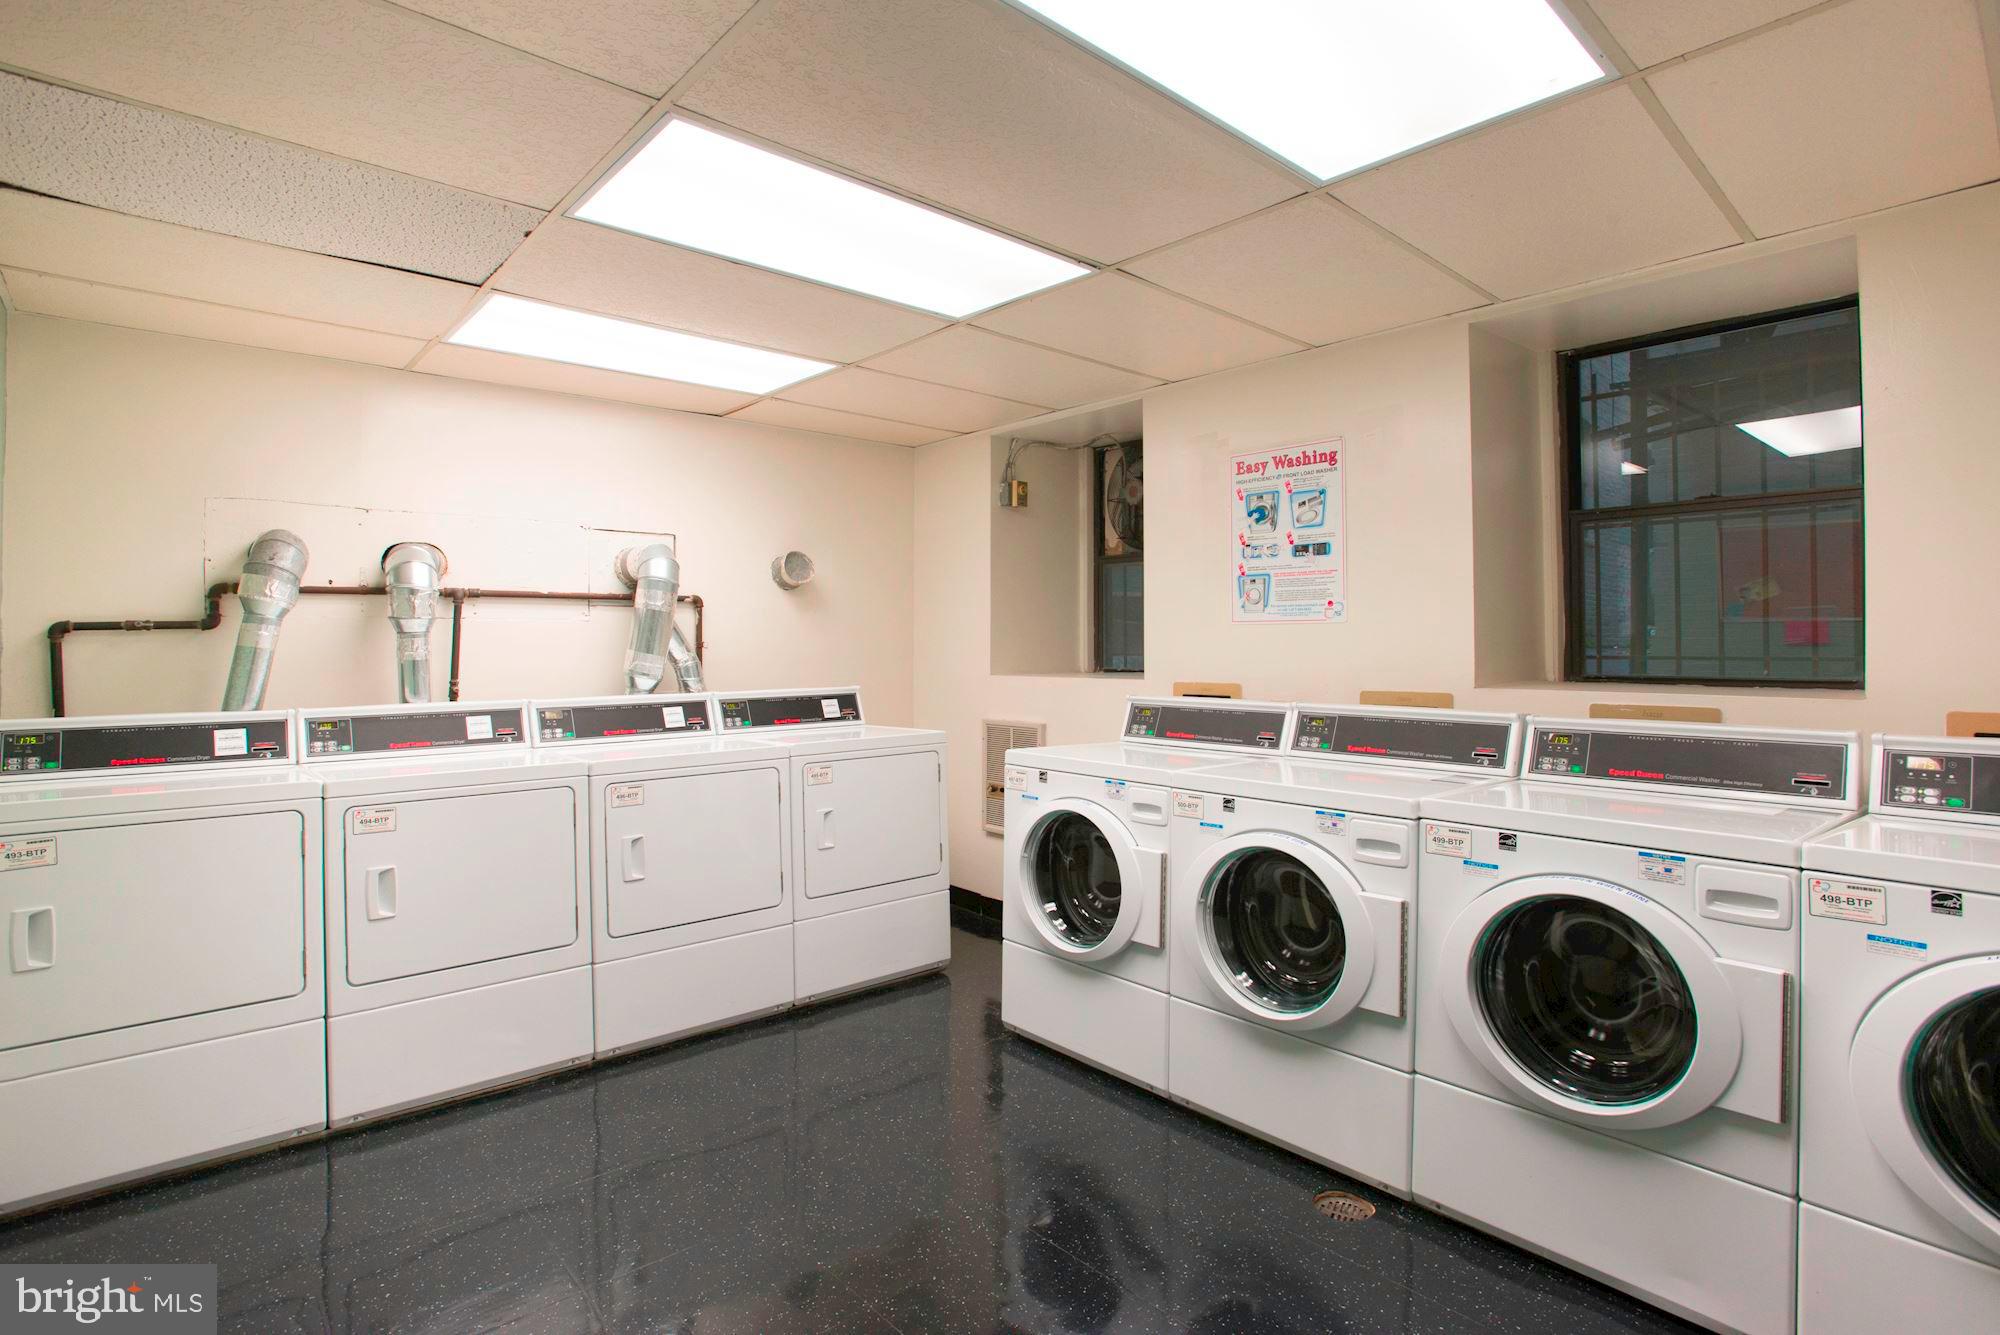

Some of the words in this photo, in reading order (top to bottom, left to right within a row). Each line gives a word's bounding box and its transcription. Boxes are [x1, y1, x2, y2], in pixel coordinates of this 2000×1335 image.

[1235, 461, 1269, 476] Easy
[1271, 449, 1338, 471] Washing
[20, 736, 37, 744] 175
[1554, 736, 1569, 745] 175
[1664, 773, 1698, 782] Commercial
[1699, 776, 1721, 784] Washer
[359, 816, 390, 825] 494-BTP
[1432, 836, 1464, 846] 499-BTP
[4, 848, 47, 860] 493-BTP
[1820, 894, 1873, 907] 498-BTP
[1874, 936, 1914, 947] NOTICE
